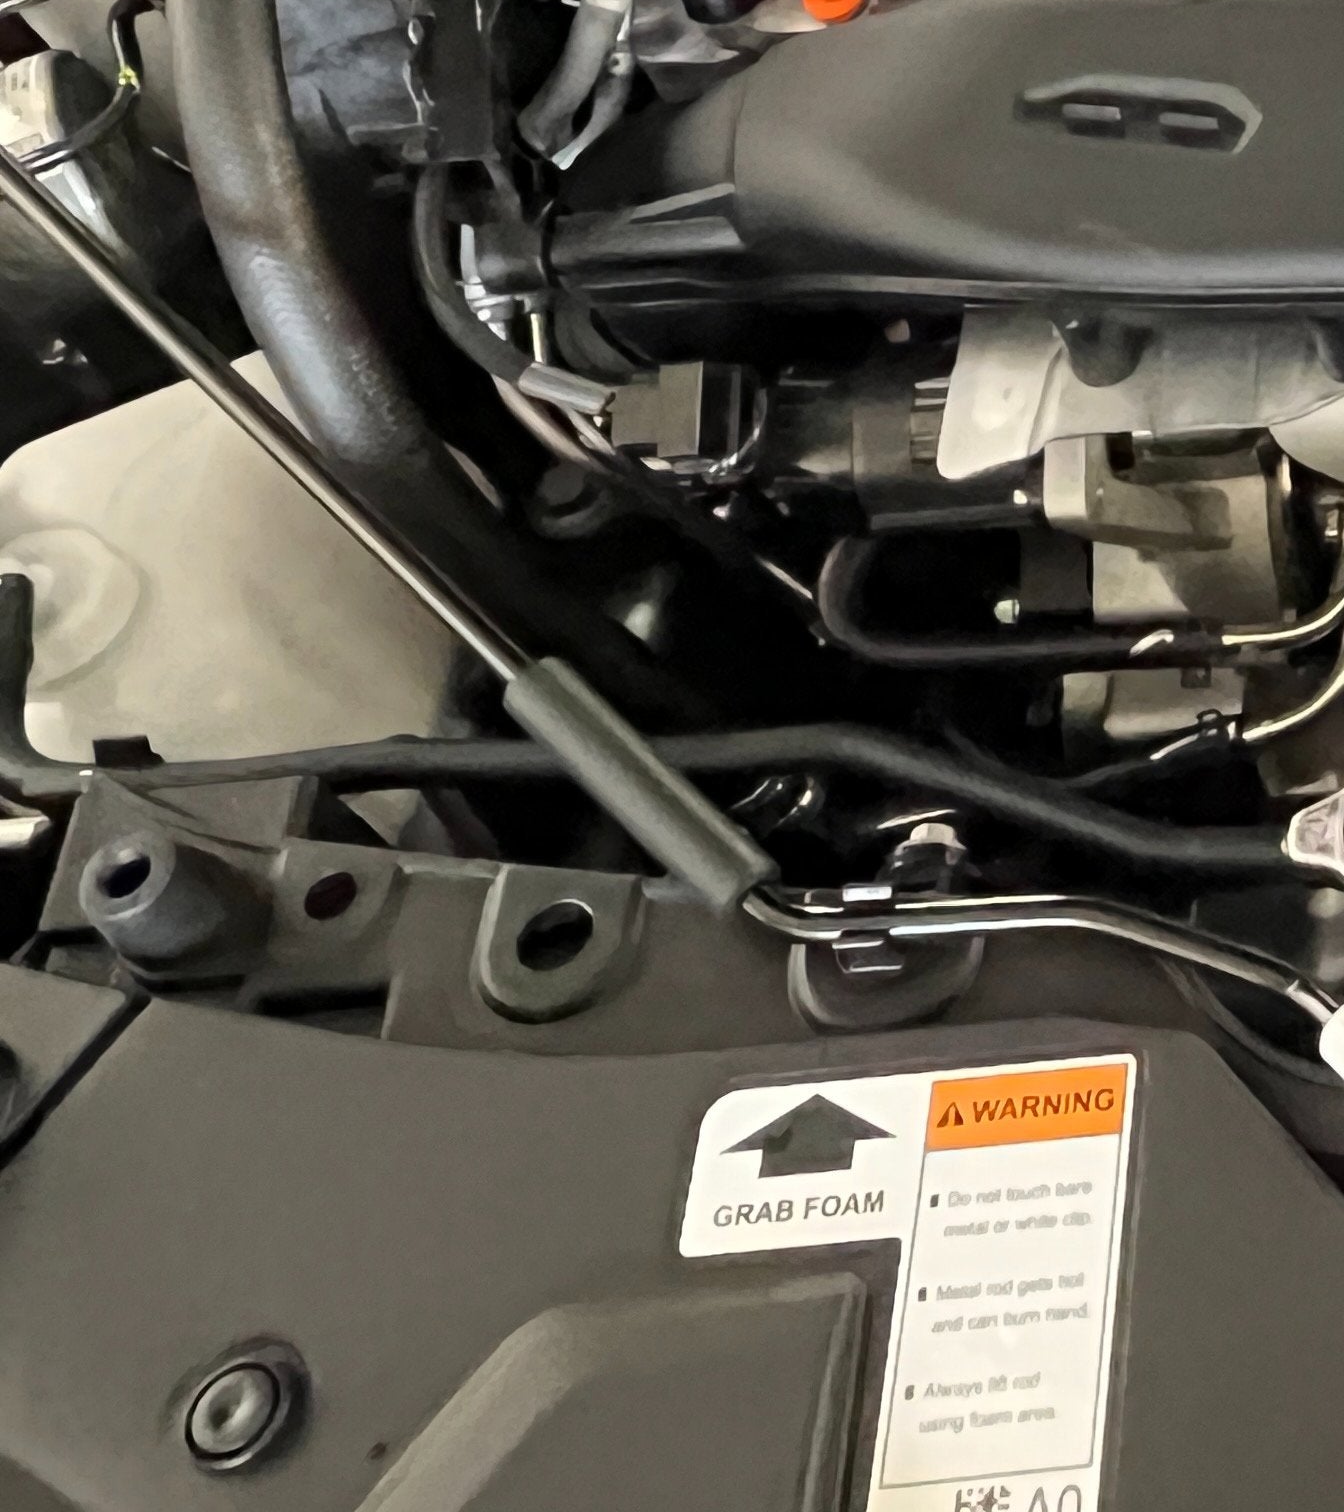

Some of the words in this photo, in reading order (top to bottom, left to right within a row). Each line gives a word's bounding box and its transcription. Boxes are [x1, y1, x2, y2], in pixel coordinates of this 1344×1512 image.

[973, 1088, 1114, 1123] WARNING
[948, 1191, 972, 1207] Do
[976, 1189, 1001, 1203] not
[1006, 1184, 1050, 1201] touch
[713, 1200, 794, 1227] GRAB
[803, 1190, 884, 1219] FOAM
[944, 1220, 990, 1237] metal
[993, 1220, 1010, 1233] or
[1015, 1215, 1058, 1230] white
[936, 1282, 982, 1301] Metal
[986, 1280, 1014, 1296] rod
[1017, 1277, 1053, 1297] gets
[1058, 1272, 1084, 1289] hot
[931, 1316, 964, 1333] and
[967, 1315, 998, 1330] can
[1003, 1311, 1041, 1327] burn
[924, 1381, 983, 1398] Always
[1012, 1371, 1041, 1390] rod
[919, 1416, 964, 1434] using
